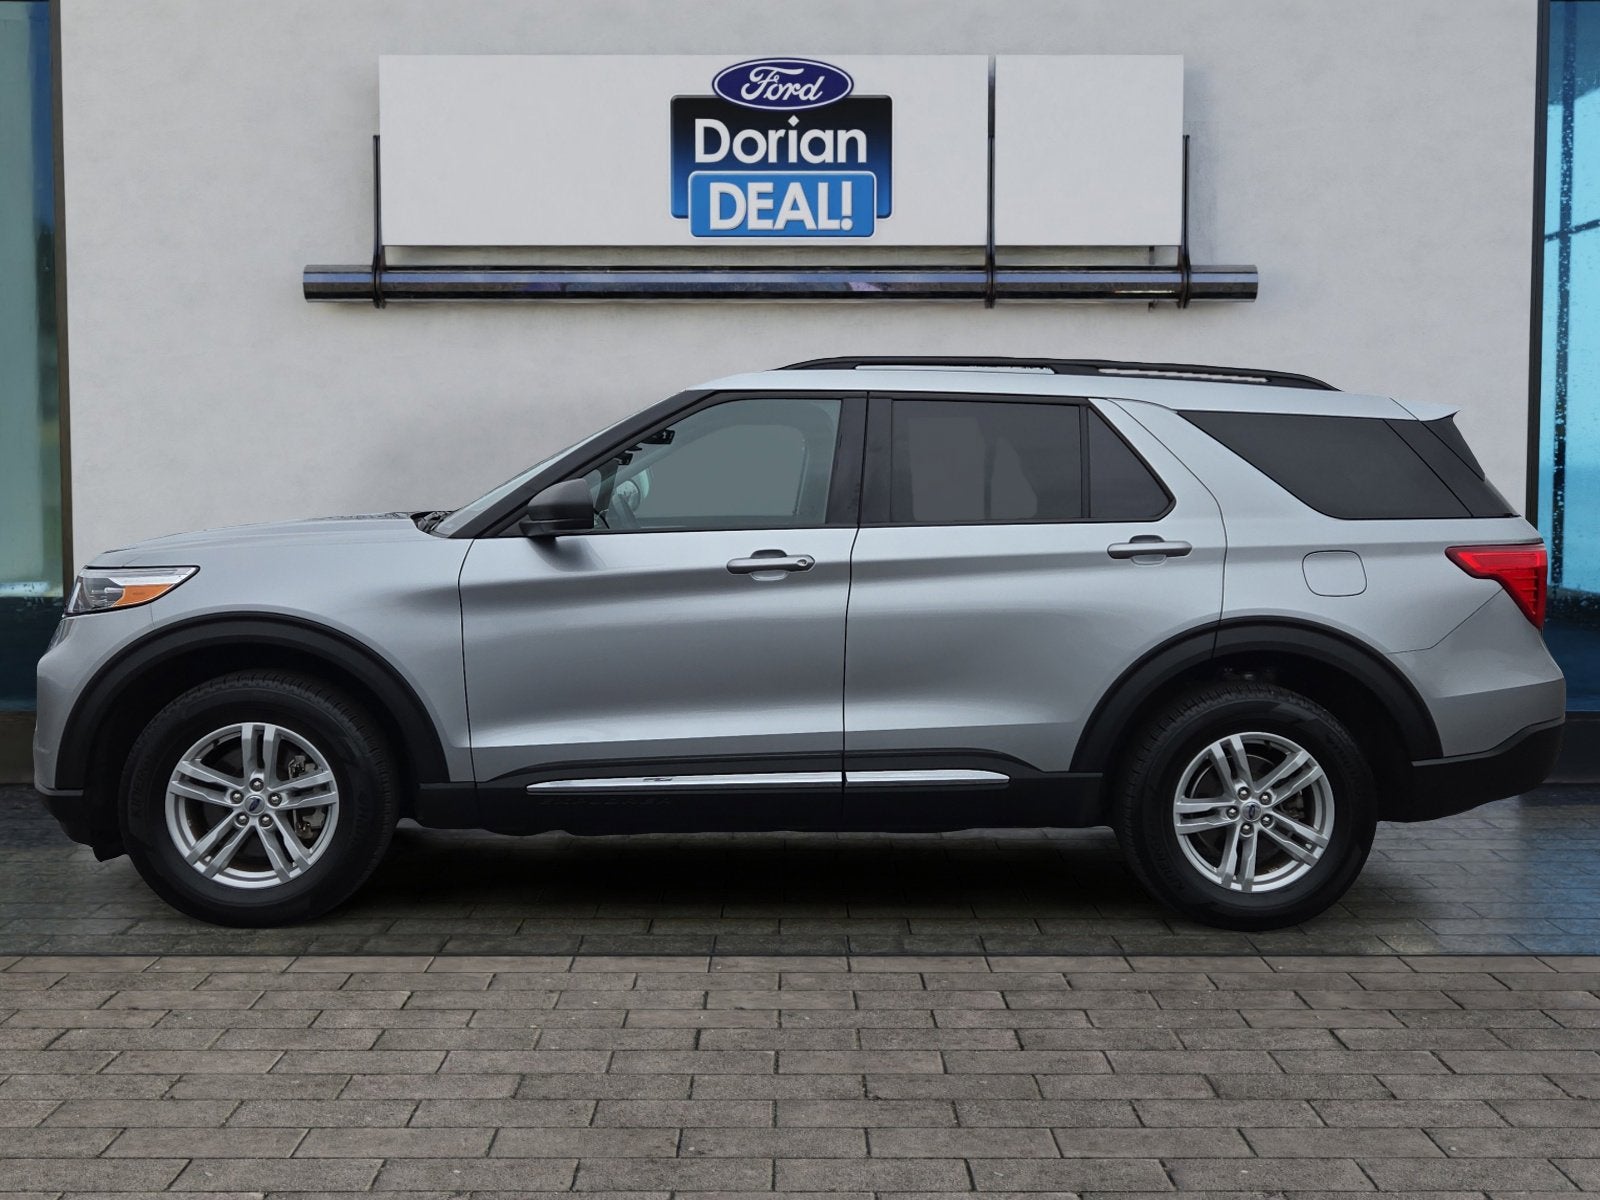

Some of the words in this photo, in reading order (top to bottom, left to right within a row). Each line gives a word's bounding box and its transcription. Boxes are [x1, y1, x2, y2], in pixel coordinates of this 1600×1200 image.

[740, 66, 826, 101] Ford
[694, 115, 867, 164] Dorian
[709, 181, 854, 231] DEAL!
